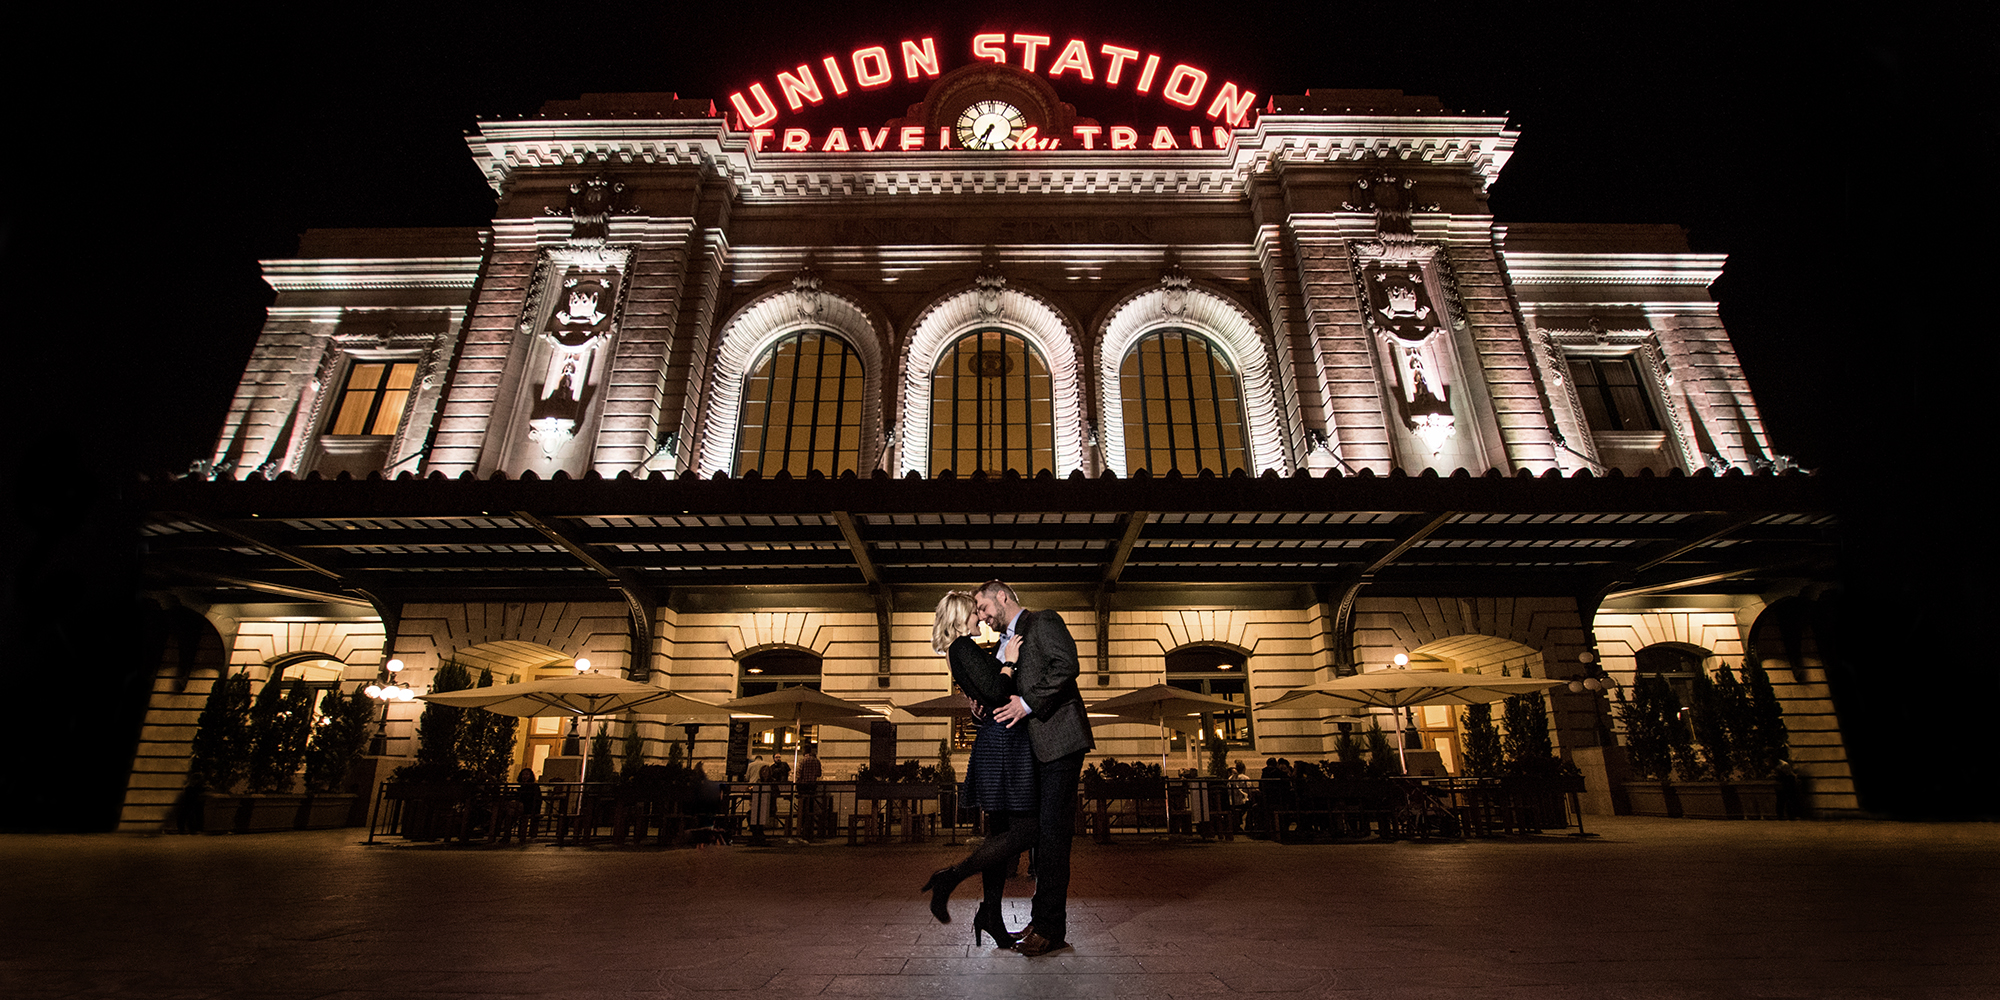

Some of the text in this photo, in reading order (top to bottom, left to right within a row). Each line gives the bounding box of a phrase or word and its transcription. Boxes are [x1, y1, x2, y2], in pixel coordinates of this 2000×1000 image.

[730, 37, 940, 128] UNION
[973, 33, 1257, 126] STATION
[753, 126, 963, 151] TRAVEL
[835, 219, 1153, 242] UNION STATION
